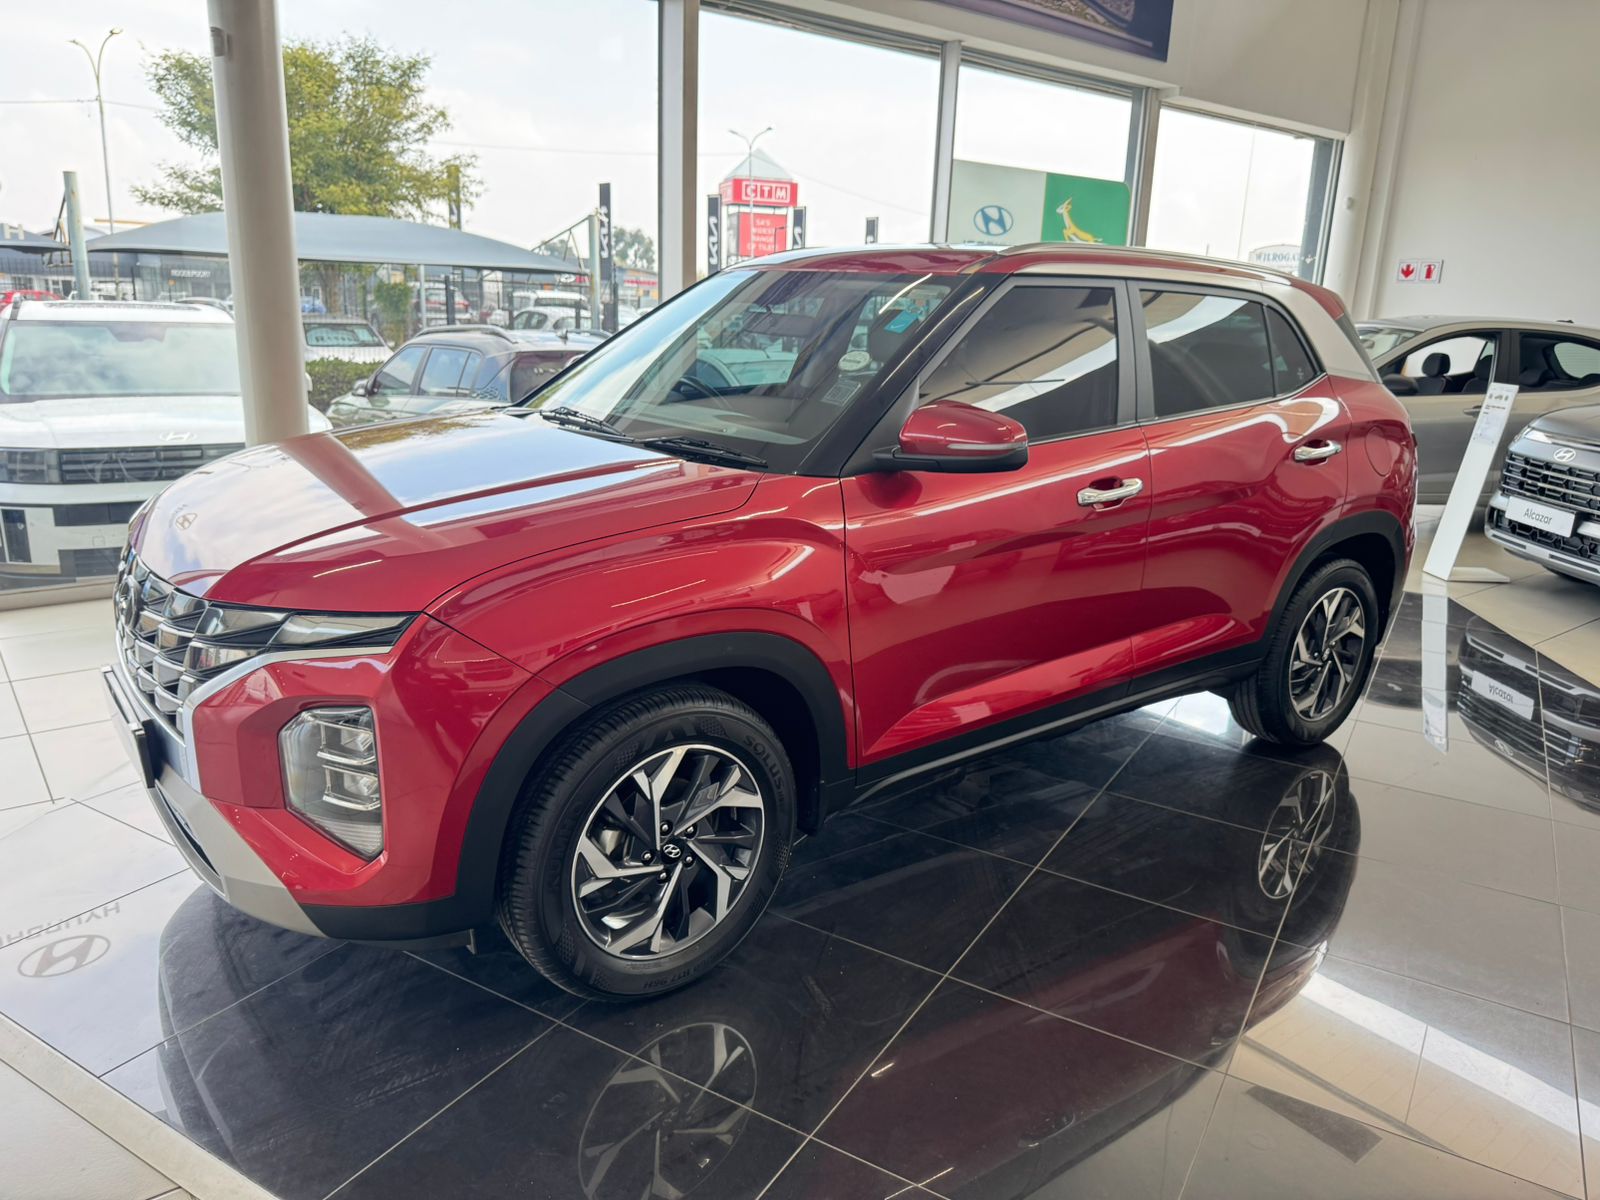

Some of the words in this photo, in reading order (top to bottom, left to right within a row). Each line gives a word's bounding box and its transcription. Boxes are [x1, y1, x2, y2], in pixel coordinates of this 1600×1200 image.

[744, 183, 788, 200] CTM
[1523, 507, 1553, 525] Alcazar
[743, 734, 785, 790] SOLUS
